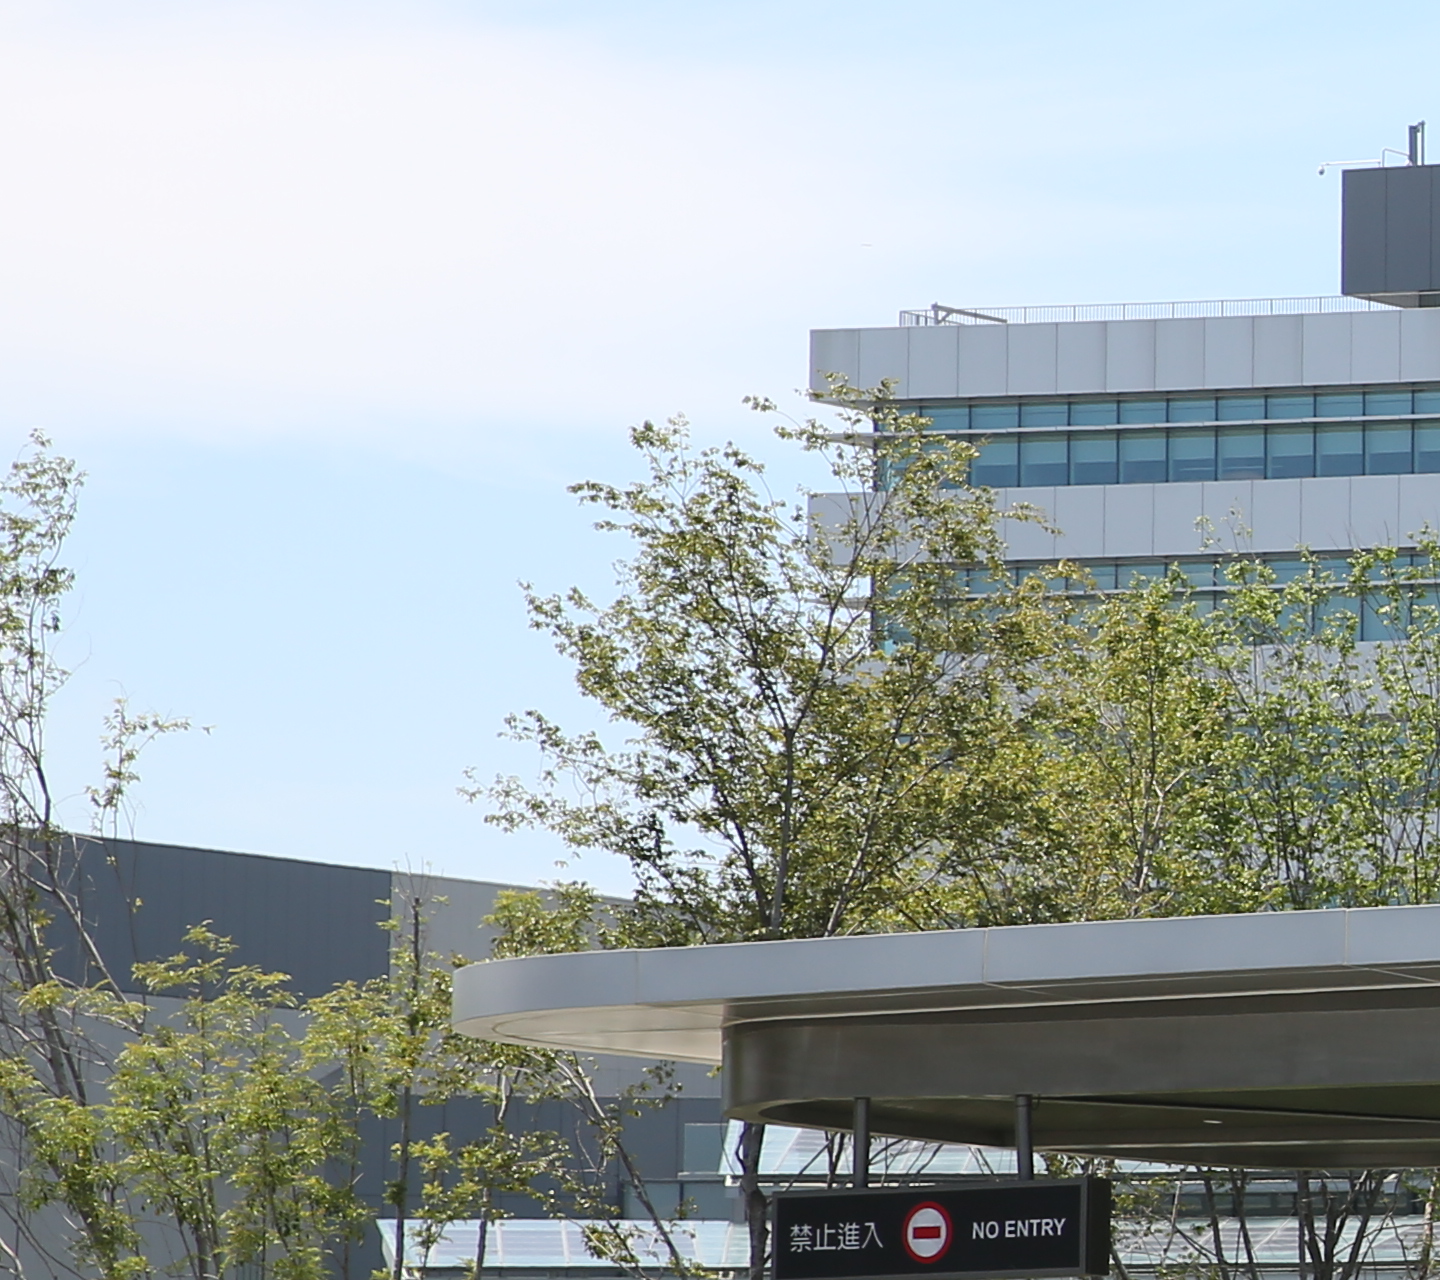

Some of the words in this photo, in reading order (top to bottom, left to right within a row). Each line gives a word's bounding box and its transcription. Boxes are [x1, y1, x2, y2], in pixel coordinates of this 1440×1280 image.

[789, 1222, 884, 1253] 禁止進入
[972, 1221, 1000, 1240] NO
[1004, 1218, 1067, 1239] ENTRY
